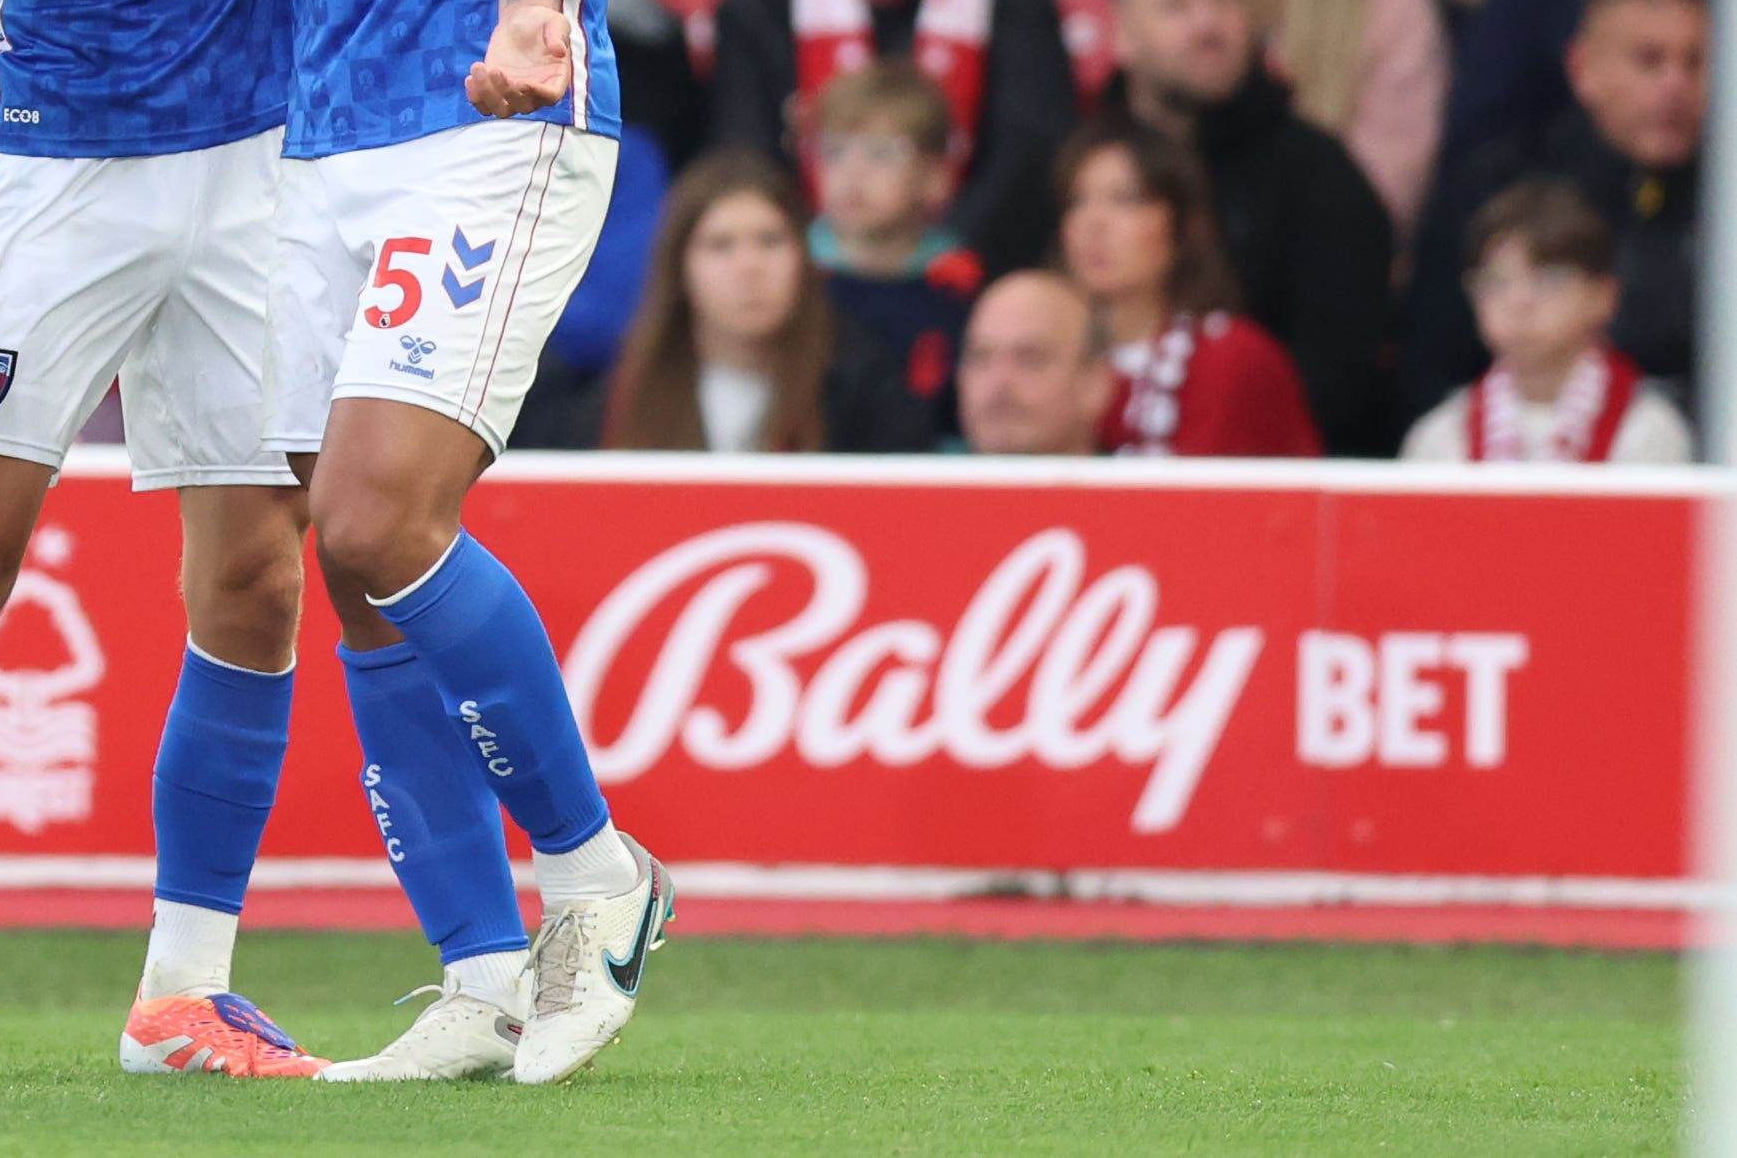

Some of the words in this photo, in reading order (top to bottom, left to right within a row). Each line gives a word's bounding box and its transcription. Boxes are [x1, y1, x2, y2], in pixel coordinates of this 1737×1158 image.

[389, 358, 435, 380] hummel
[557, 522, 1266, 835] Bally
[1297, 632, 1528, 769] BET
[459, 700, 514, 777] SAFC
[364, 763, 406, 863] SAFC
